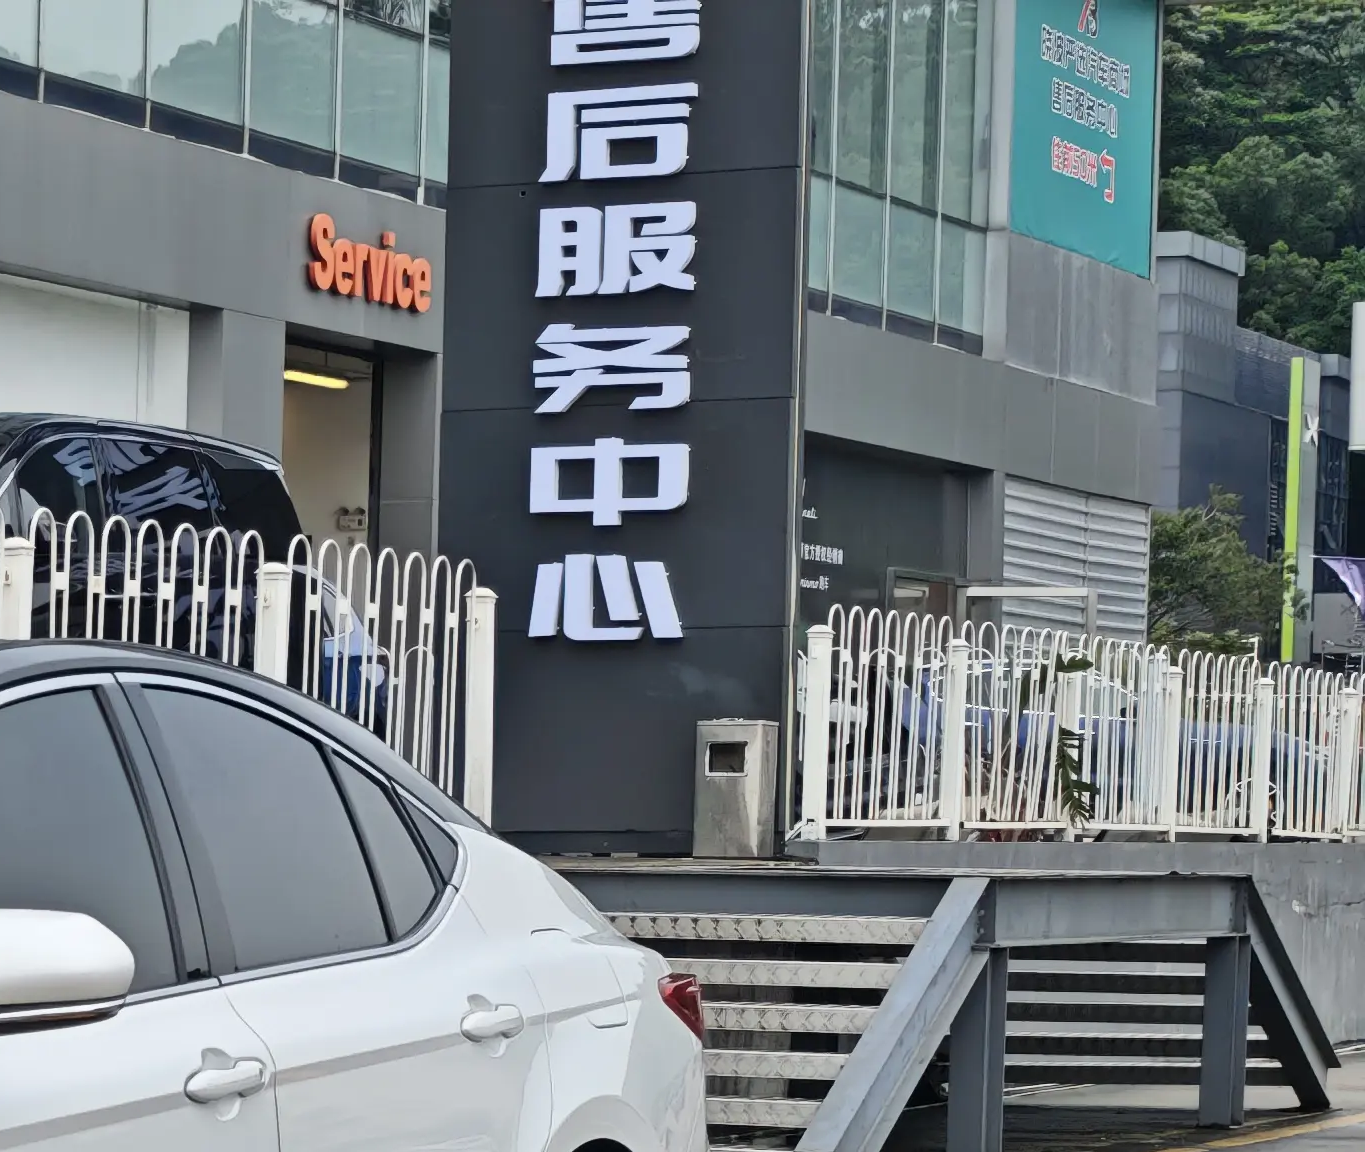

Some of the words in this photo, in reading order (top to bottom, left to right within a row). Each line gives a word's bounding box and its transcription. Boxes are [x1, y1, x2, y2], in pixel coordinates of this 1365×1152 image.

[1051, 77, 1117, 138] 售后服务中心
[309, 213, 432, 312] Service
[527, 0, 703, 641] 售后服务中心
